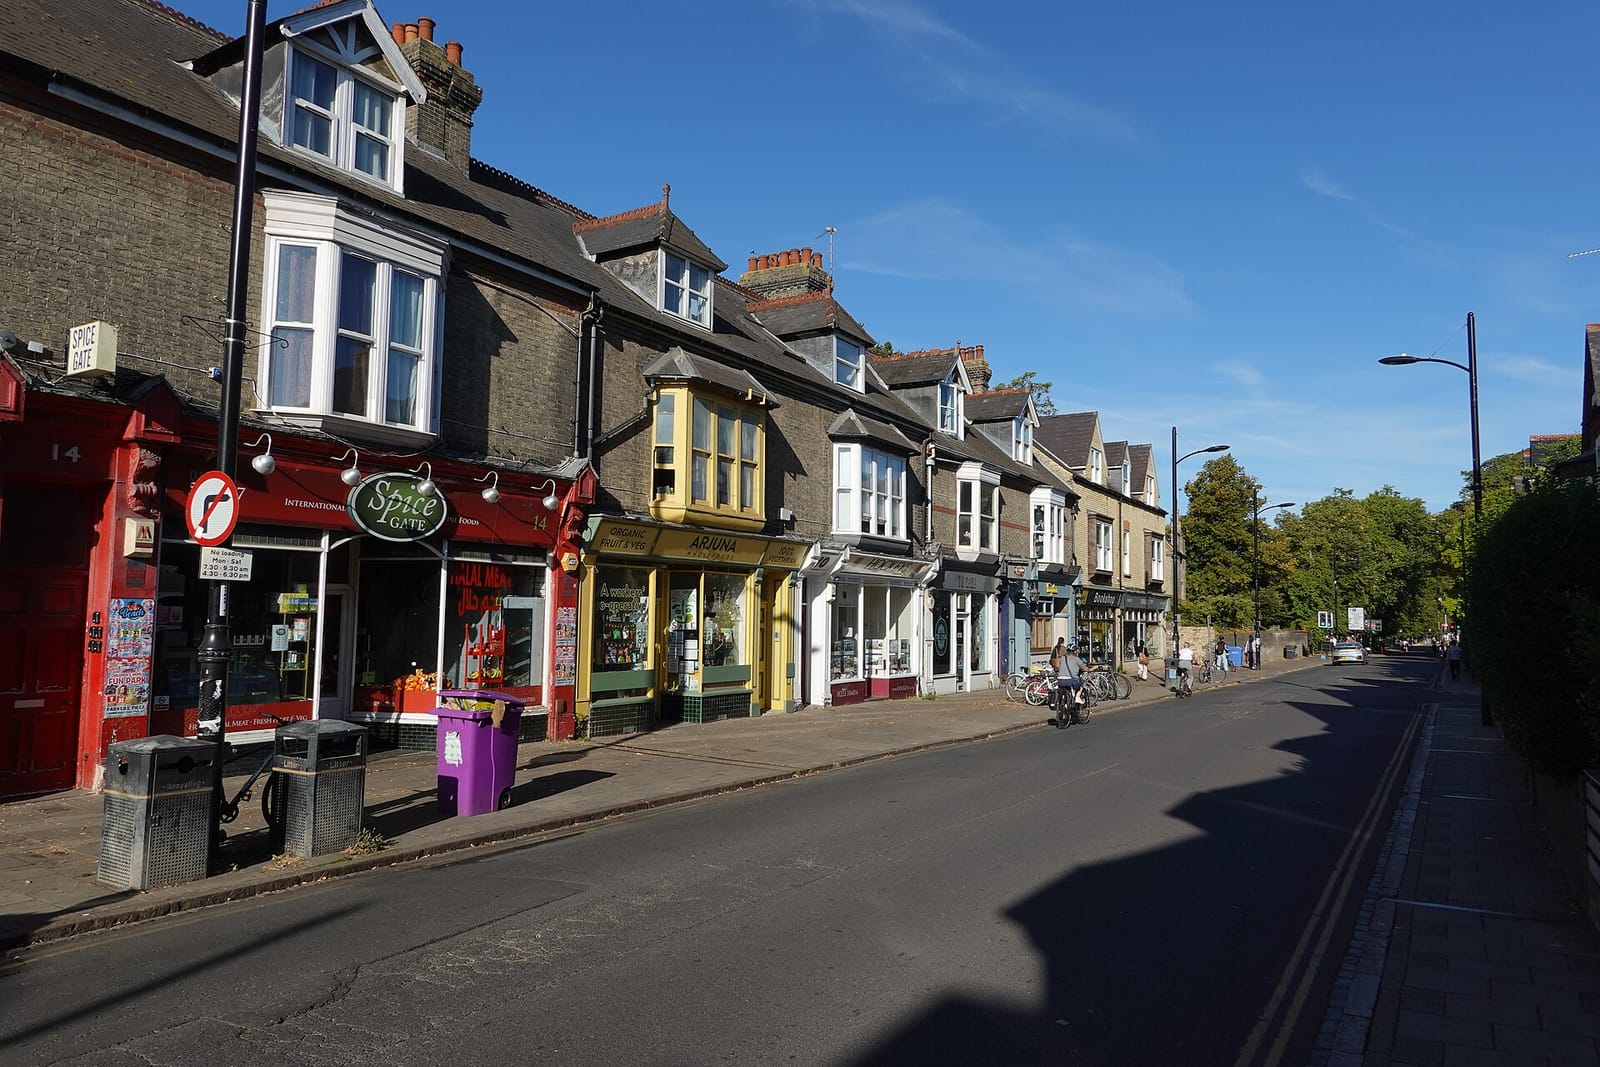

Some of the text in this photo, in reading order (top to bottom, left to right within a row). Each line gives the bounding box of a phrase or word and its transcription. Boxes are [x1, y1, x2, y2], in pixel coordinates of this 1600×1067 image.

[72, 325, 96, 349] SPICE
[73, 348, 93, 371] GATE
[52, 443, 82, 463] 14
[284, 497, 347, 512] INTERNATIONAL
[367, 479, 438, 524] Spice
[389, 516, 427, 532] GATE
[533, 514, 547, 531] 14
[610, 527, 647, 539] ORGANIC
[600, 537, 646, 550] FRUIT & VEG
[689, 535, 737, 553] ARJUNA
[814, 556, 831, 568] 10
[600, 582, 609, 597] A
[109, 676, 147, 685] FUN PARK
[253, 716, 272, 726] FRESH
